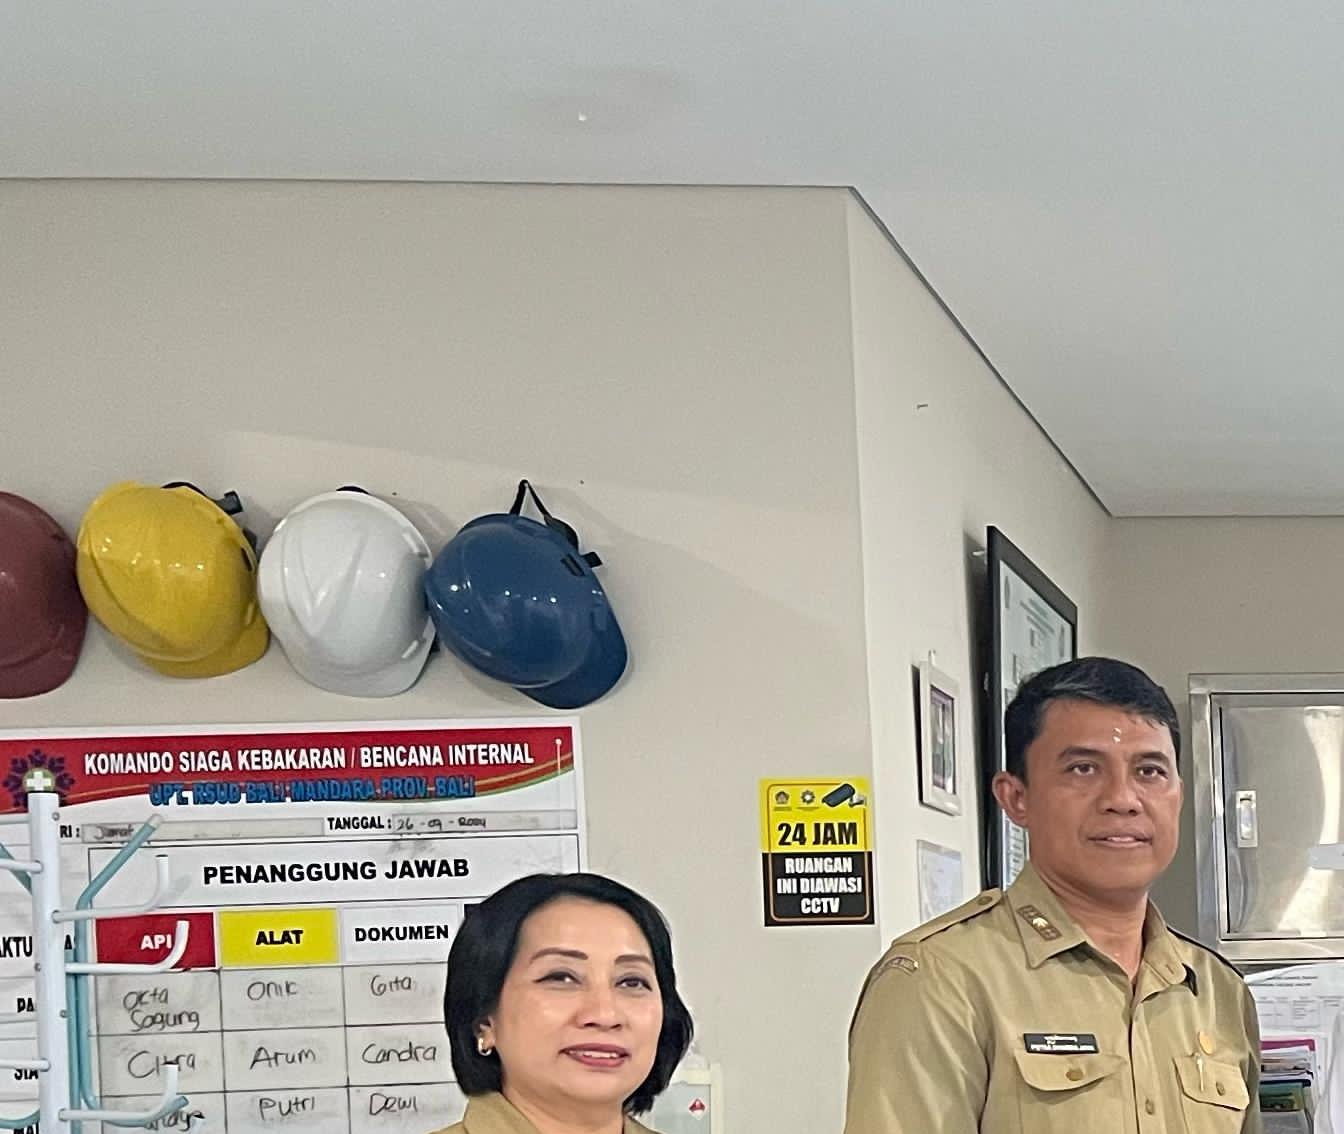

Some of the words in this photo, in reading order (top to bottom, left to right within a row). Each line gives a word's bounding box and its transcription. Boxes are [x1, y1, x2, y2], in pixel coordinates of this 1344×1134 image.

[84, 751, 174, 775] KOMANDO
[179, 749, 233, 773] SIAGA
[238, 747, 346, 771] KEBAKARAN
[360, 746, 444, 768] BENCANA
[449, 743, 535, 765] INTERNAL
[192, 781, 241, 804] RSUD
[245, 780, 286, 804] BALI
[291, 778, 376, 802] MANDARA
[434, 774, 476, 798] BALI
[327, 816, 385, 831] TANGGAL
[777, 822, 806, 846] 24
[812, 822, 858, 846] JAM
[203, 861, 377, 885] PENANGGUNG
[385, 858, 469, 879] JAWAB
[784, 857, 853, 874] RUANGAN
[776, 878, 798, 894] INI
[800, 877, 862, 894] DIAWASI
[800, 897, 840, 914] CCTV
[140, 934, 172, 950] API
[255, 929, 303, 946] ALAT
[355, 925, 449, 942] DOKUMEN
[249, 1046, 316, 1071] Arum
[362, 1041, 437, 1064] Candra
[259, 1096, 315, 1121] Putri
[369, 1092, 418, 1116] Dewi
